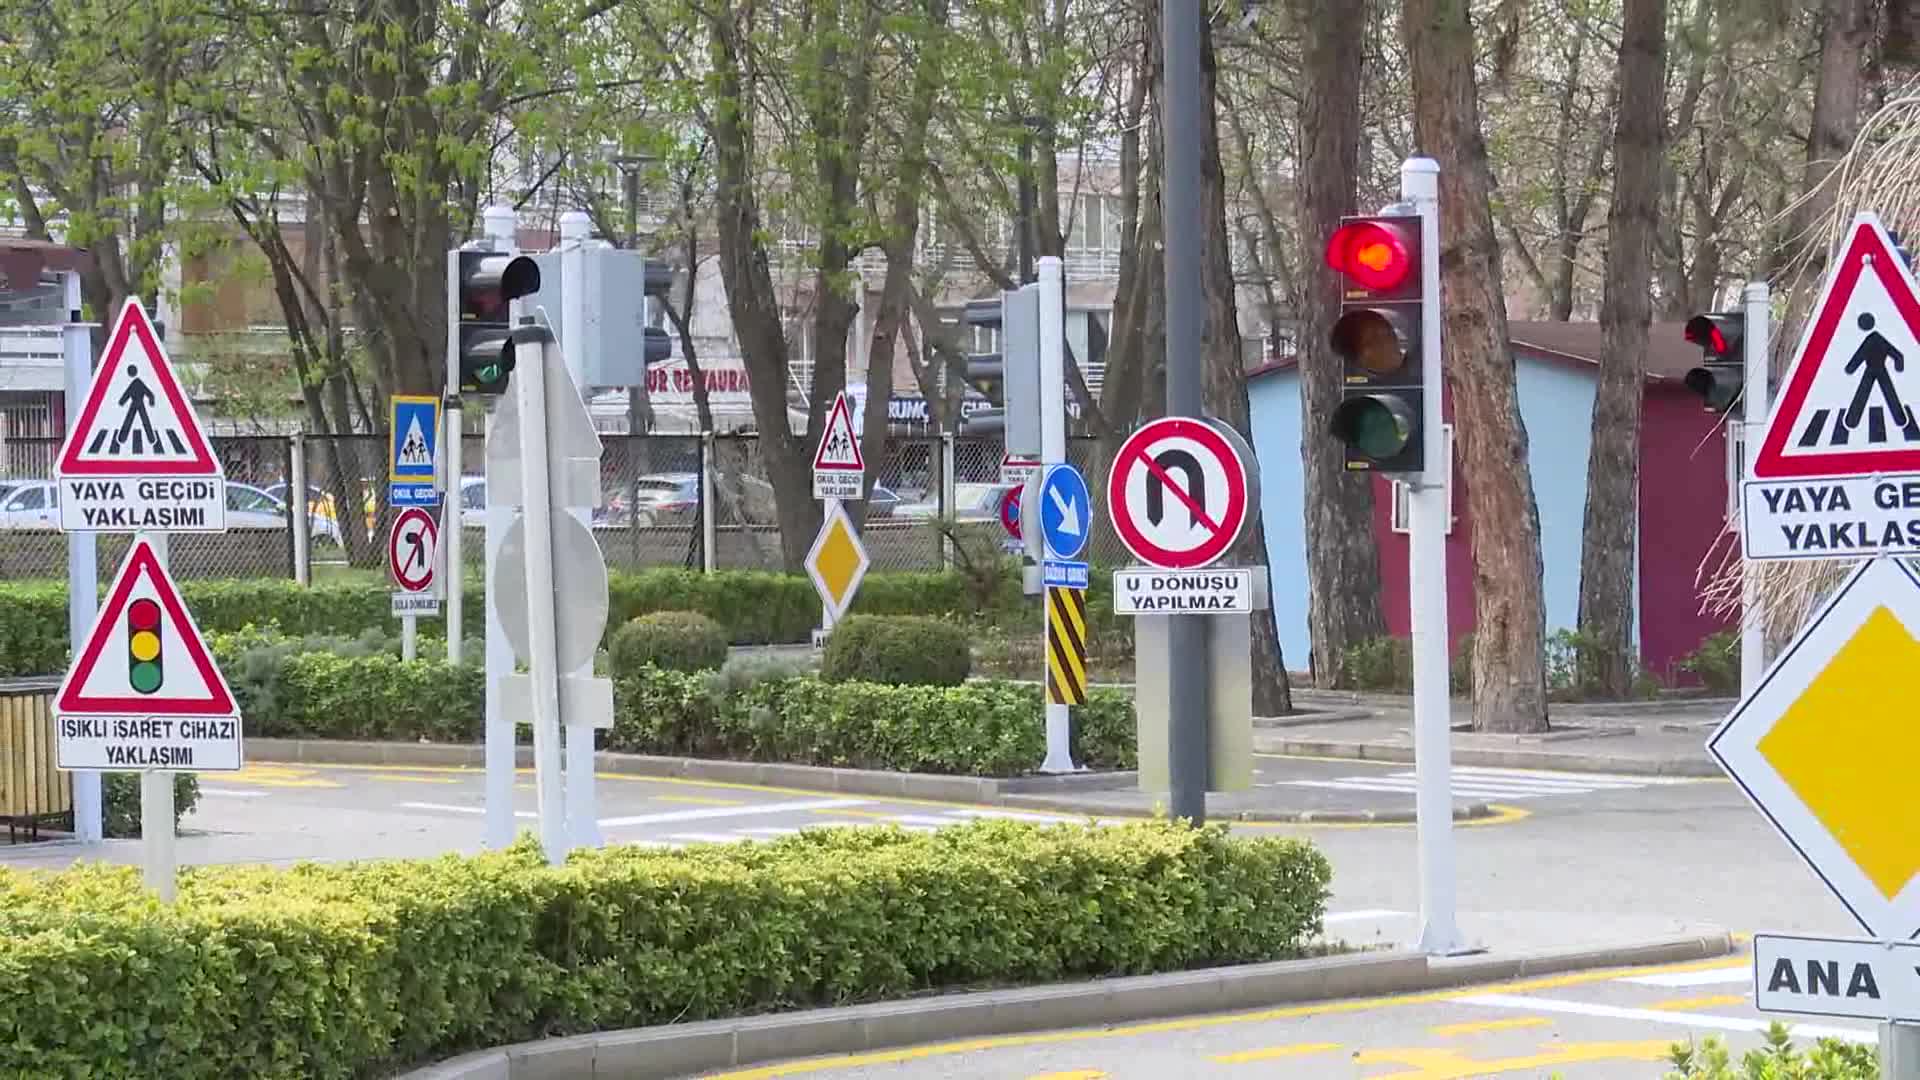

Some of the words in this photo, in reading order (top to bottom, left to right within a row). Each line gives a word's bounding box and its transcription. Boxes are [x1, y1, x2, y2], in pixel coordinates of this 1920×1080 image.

[70, 482, 125, 500] YAYA
[1760, 485, 1852, 514] YAYA
[1874, 482, 1920, 510] GE
[82, 507, 205, 528] YAKLAŞIMI
[1126, 577, 1140, 591] U
[1151, 573, 1239, 593] DÖNÜŞÜ
[1131, 595, 1237, 610] YAPILMAZ
[105, 745, 193, 767] YAKLAŞIMI
[1767, 957, 1881, 1000] ANA
